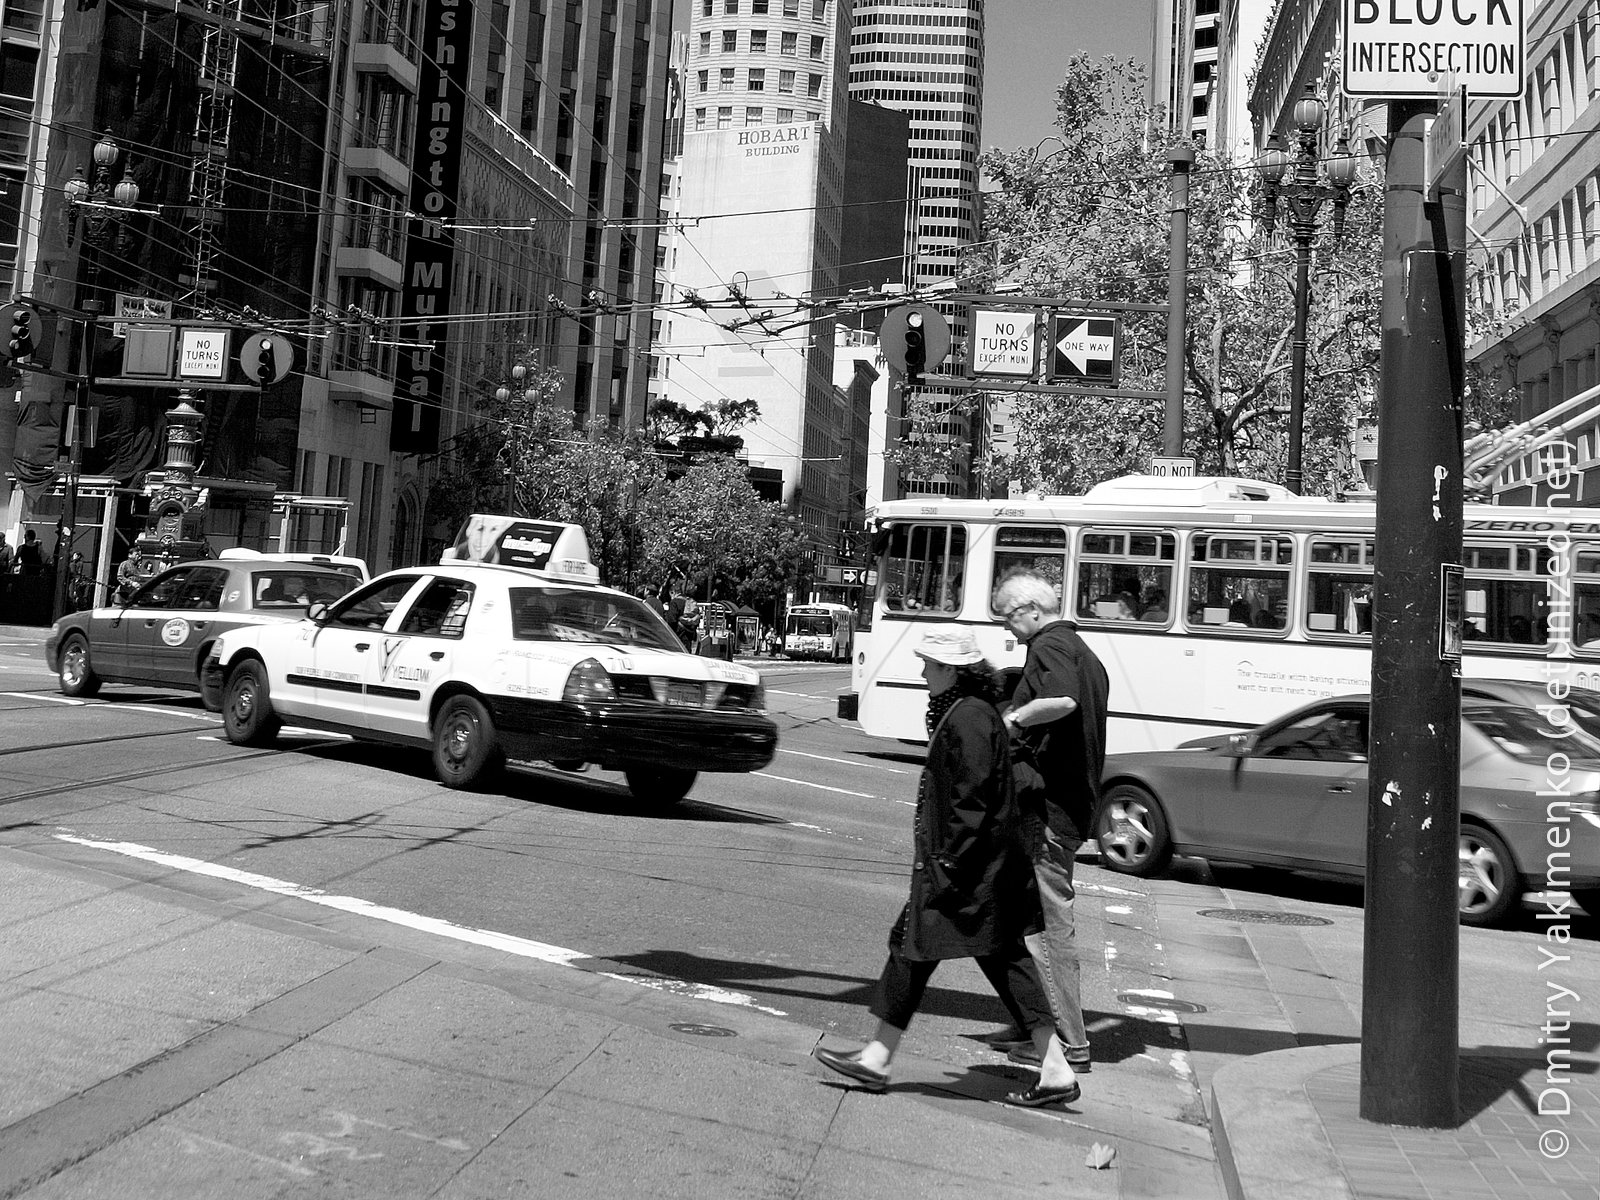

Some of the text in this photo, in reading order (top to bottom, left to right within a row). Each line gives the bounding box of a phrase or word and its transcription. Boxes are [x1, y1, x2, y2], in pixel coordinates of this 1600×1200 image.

[1352, 42, 1515, 75] INTERSECTION
[737, 126, 810, 145] HOBART
[745, 145, 800, 157] BUILDING
[995, 323, 1015, 336] NO
[196, 340, 211, 349] NO
[409, 262, 443, 432] Mutual
[981, 337, 1029, 352] TURNS
[1064, 341, 1110, 352] ONE WAY
[186, 350, 219, 361] TURNS
[979, 353, 1029, 365] EXCEPT MUNI
[1153, 465, 1192, 477] DO NOT
[1466, 520, 1555, 531] ZERO
[392, 665, 431, 681] YELLOW
